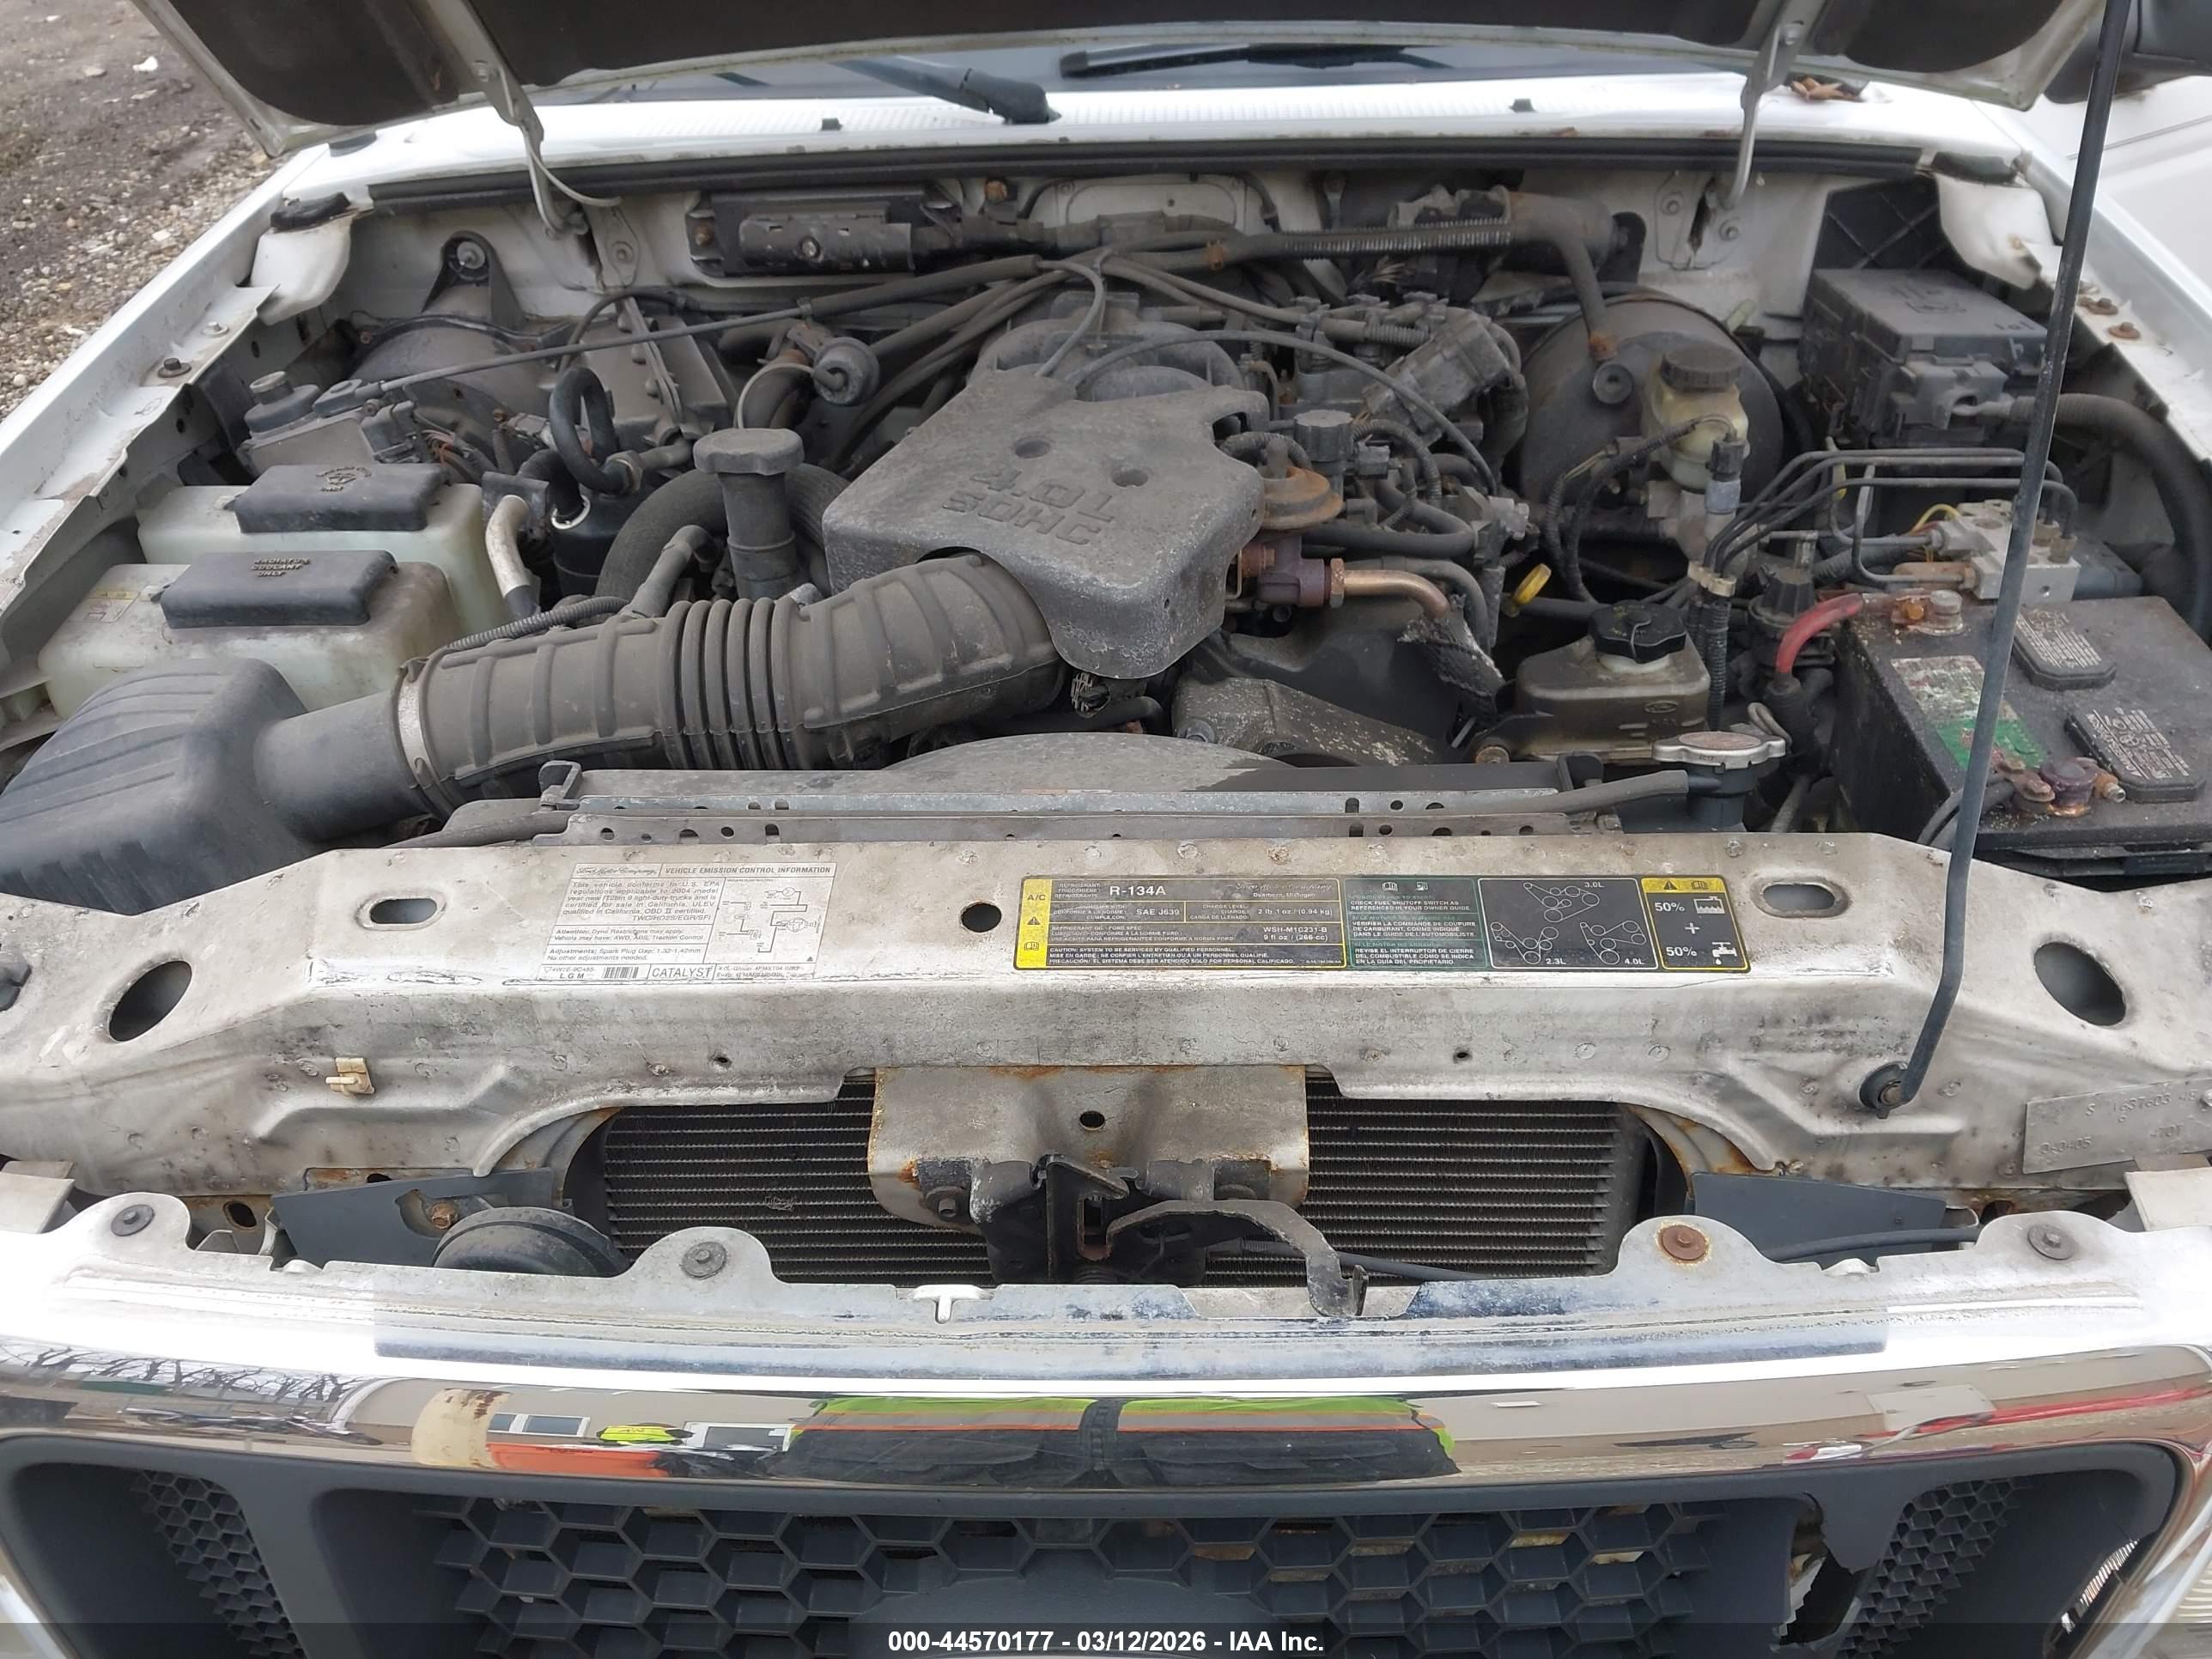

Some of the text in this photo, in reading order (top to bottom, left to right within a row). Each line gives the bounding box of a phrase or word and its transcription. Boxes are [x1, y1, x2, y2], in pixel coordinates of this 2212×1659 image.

[942, 490, 1102, 545] SOHC
[1109, 886, 1166, 896] R-134A
[1655, 902, 1685, 911] 50%
[1666, 947, 1697, 957] 50%
[652, 966, 714, 979] CATALYST
